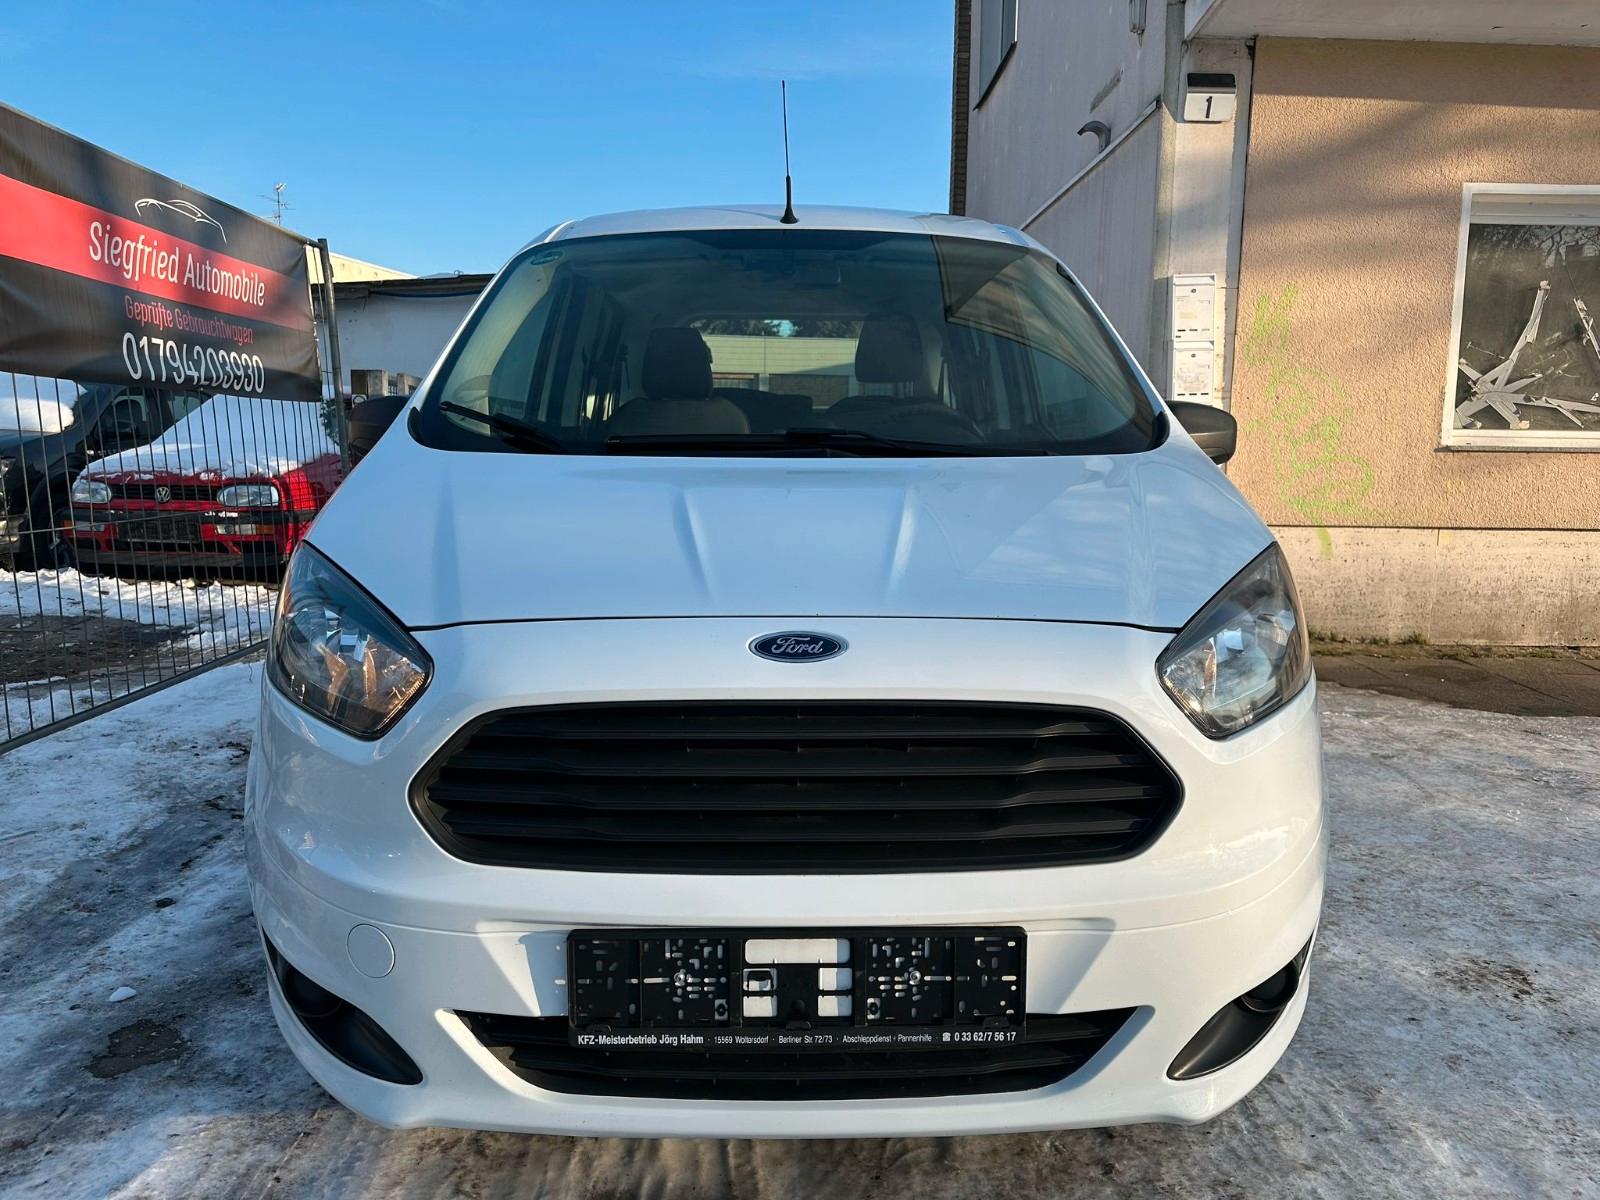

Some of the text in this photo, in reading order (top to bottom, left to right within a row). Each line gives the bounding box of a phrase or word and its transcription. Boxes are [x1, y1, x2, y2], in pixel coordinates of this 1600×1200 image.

[1205, 95, 1213, 119] 1
[88, 221, 266, 307] Siegfried Automobile
[124, 295, 254, 346] Geprüfte Gebrauchtwagen
[122, 332, 265, 393] 01794203930
[771, 636, 824, 654] Ford
[577, 1034, 658, 1045] KFZ-Meisterbetrieb
[659, 1034, 678, 1046] Jörg
[680, 1034, 704, 1044] Hahm
[714, 1035, 733, 1044] 15569
[778, 1035, 803, 1044] Berliner
[814, 1035, 833, 1044] 72/73
[842, 1034, 892, 1045] Abschleppdienst
[897, 1033, 933, 1043] Pannenhilfe
[954, 1032, 960, 1042] 0
[961, 1032, 972, 1042] 33
[973, 1031, 993, 1042] 62/7
[994, 1031, 1005, 1042] 56
[1006, 1031, 1017, 1042] 17
